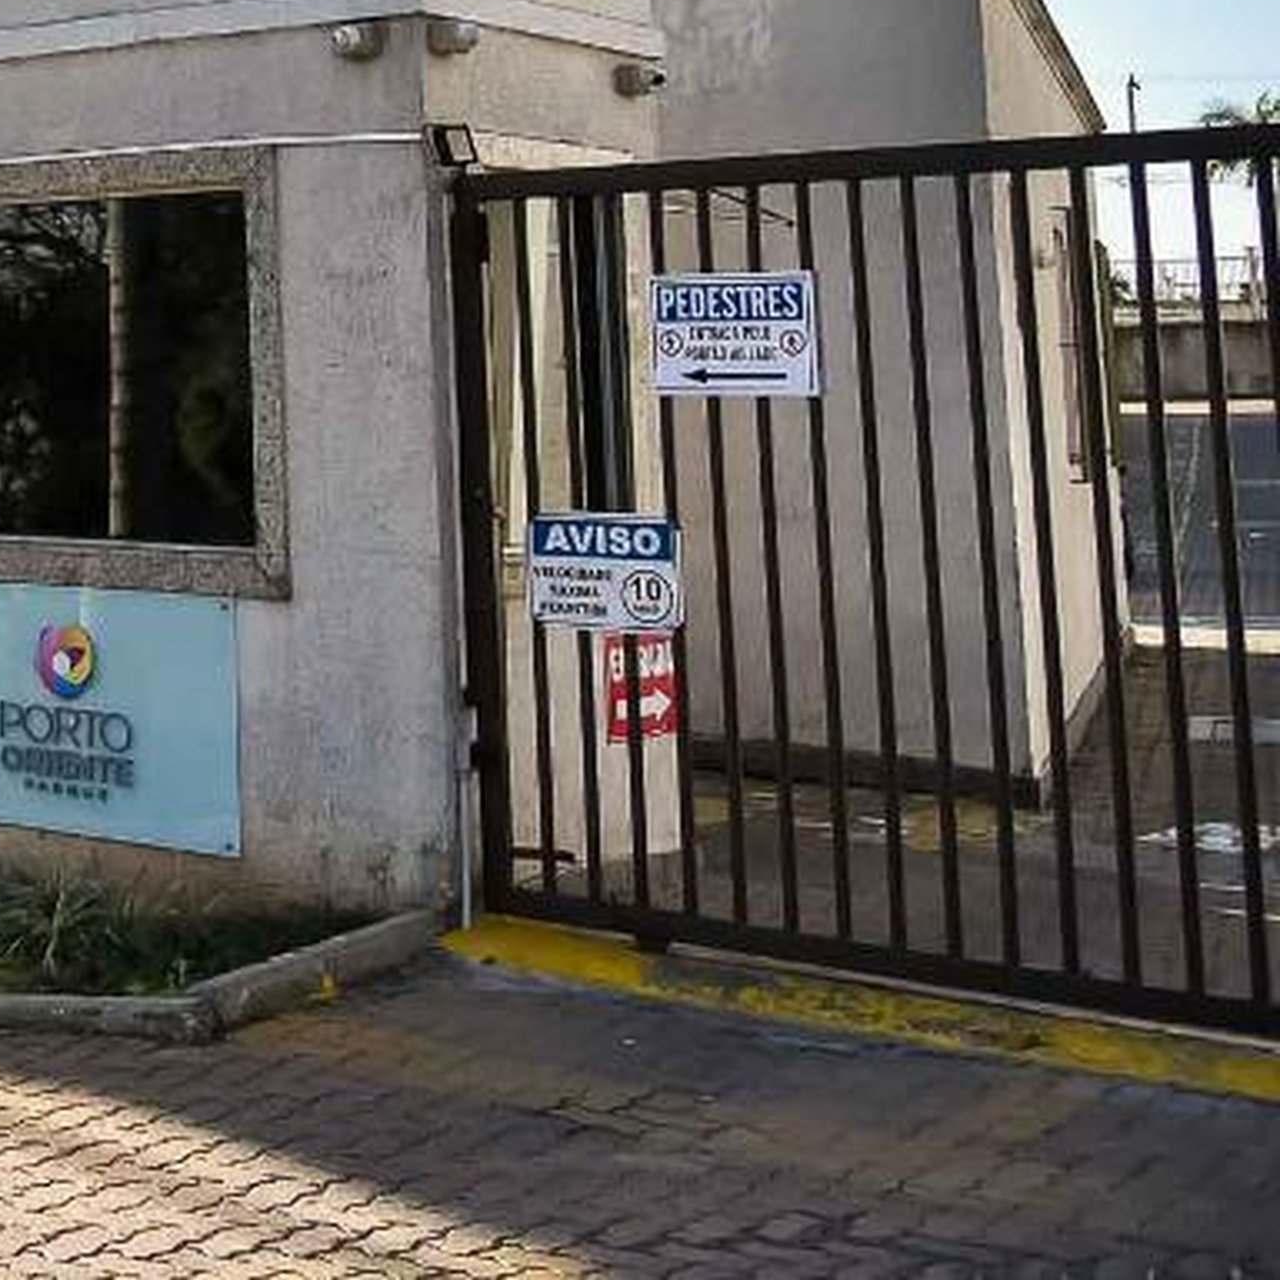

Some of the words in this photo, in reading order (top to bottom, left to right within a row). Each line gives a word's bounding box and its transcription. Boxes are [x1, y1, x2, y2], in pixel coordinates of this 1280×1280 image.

[659, 285, 799, 319] PEDESTRES
[544, 523, 662, 556] AVISO
[630, 576, 661, 601] 10
[0, 700, 133, 753] PORTO
